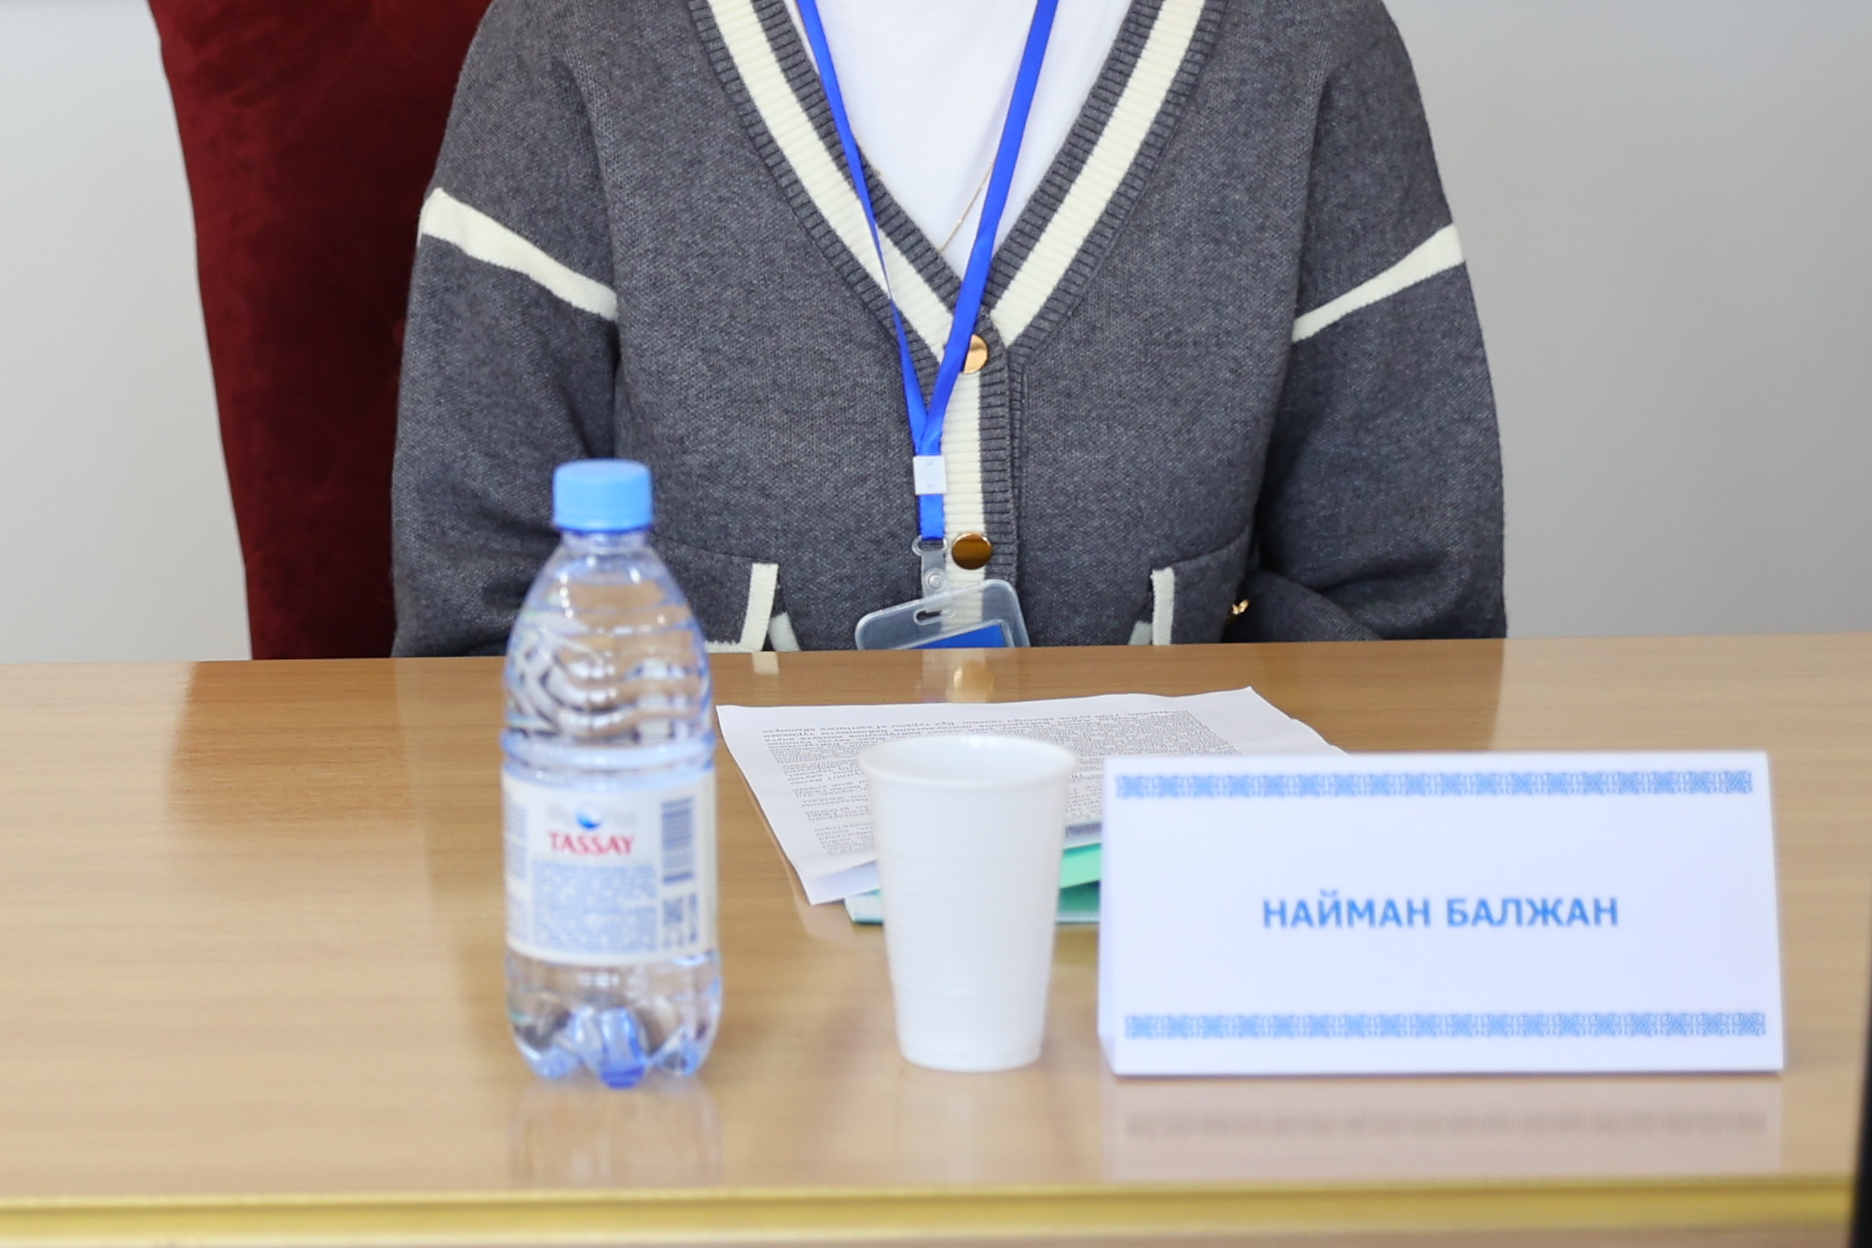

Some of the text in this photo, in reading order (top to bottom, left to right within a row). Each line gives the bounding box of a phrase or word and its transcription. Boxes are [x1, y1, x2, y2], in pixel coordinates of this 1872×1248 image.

[548, 832, 634, 856] TASSAY
[1262, 890, 1619, 928] НАЙМАН БАЛЖАН
